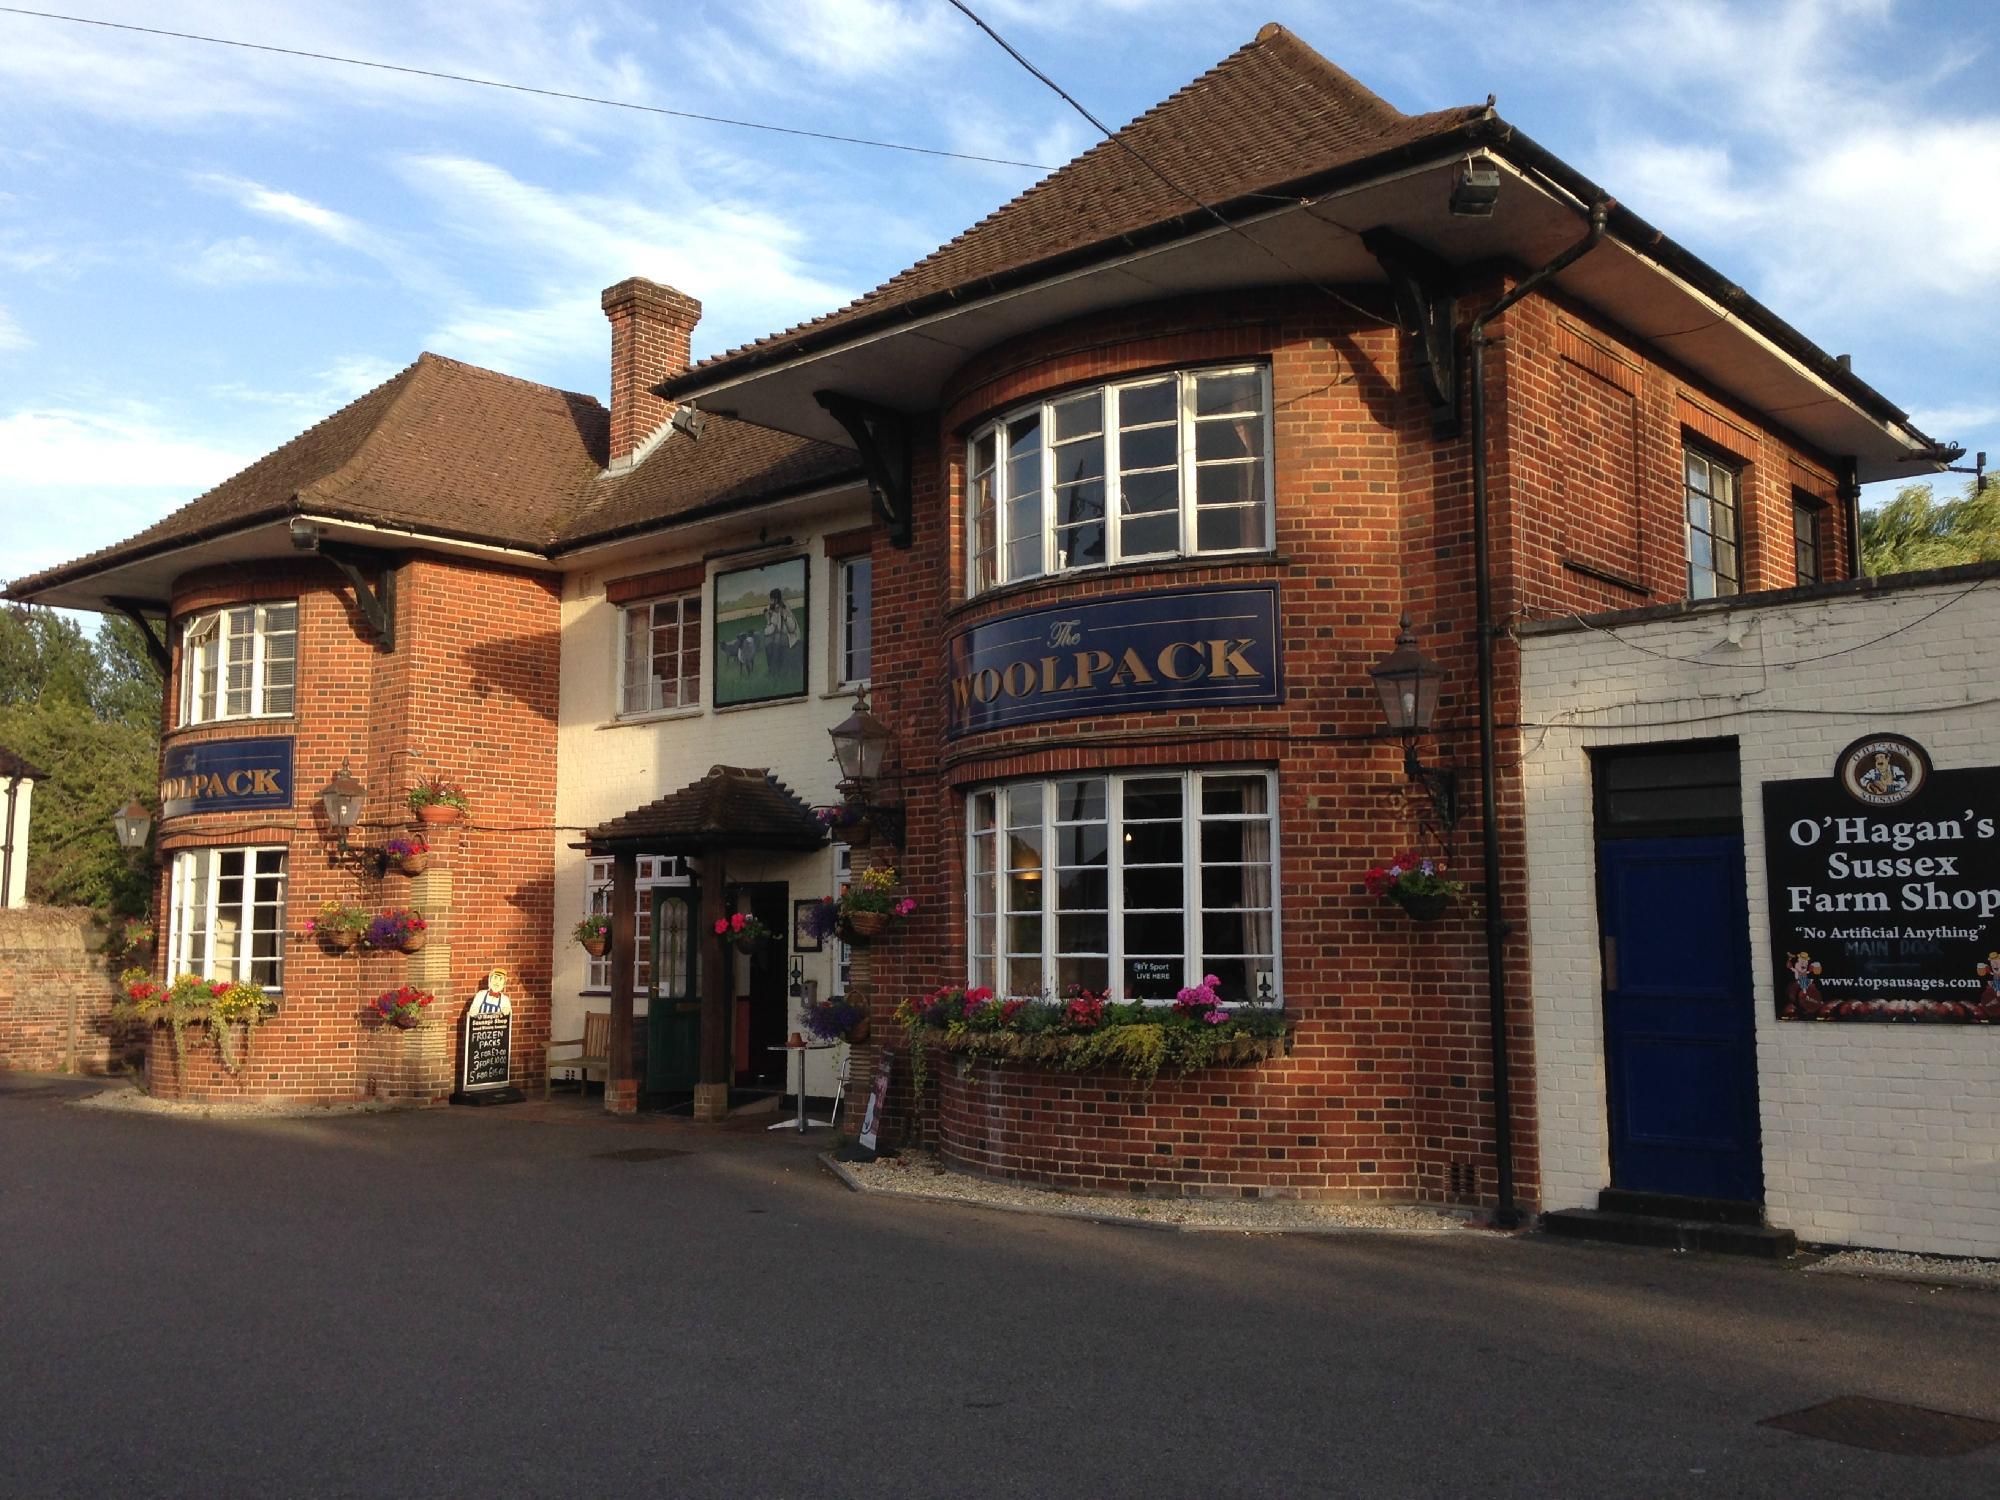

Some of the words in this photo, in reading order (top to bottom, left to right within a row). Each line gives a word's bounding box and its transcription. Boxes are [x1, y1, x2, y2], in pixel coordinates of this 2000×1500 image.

[1046, 619, 1081, 648] The
[952, 638, 1265, 707] WOOLPACK
[1789, 809, 1995, 851] O'Hagan's
[1828, 852, 1959, 880] Sussex
[1787, 886, 1891, 913] Farm
[1901, 881, 2000, 918] Shop
[1830, 926, 1899, 939] Artificial
[1150, 963, 1169, 971] Sport
[1820, 977, 1981, 991] www.topsausages.com
[472, 1030, 504, 1042] FROZEN
[479, 1040, 501, 1049] PACKS
[473, 1050, 479, 1060] 2
[480, 1050, 491, 1058] FOR
[473, 1060, 479, 1071] 3
[479, 1058, 490, 1068] FOR
[469, 1070, 476, 1082] 5
[476, 1071, 488, 1080] FOR
